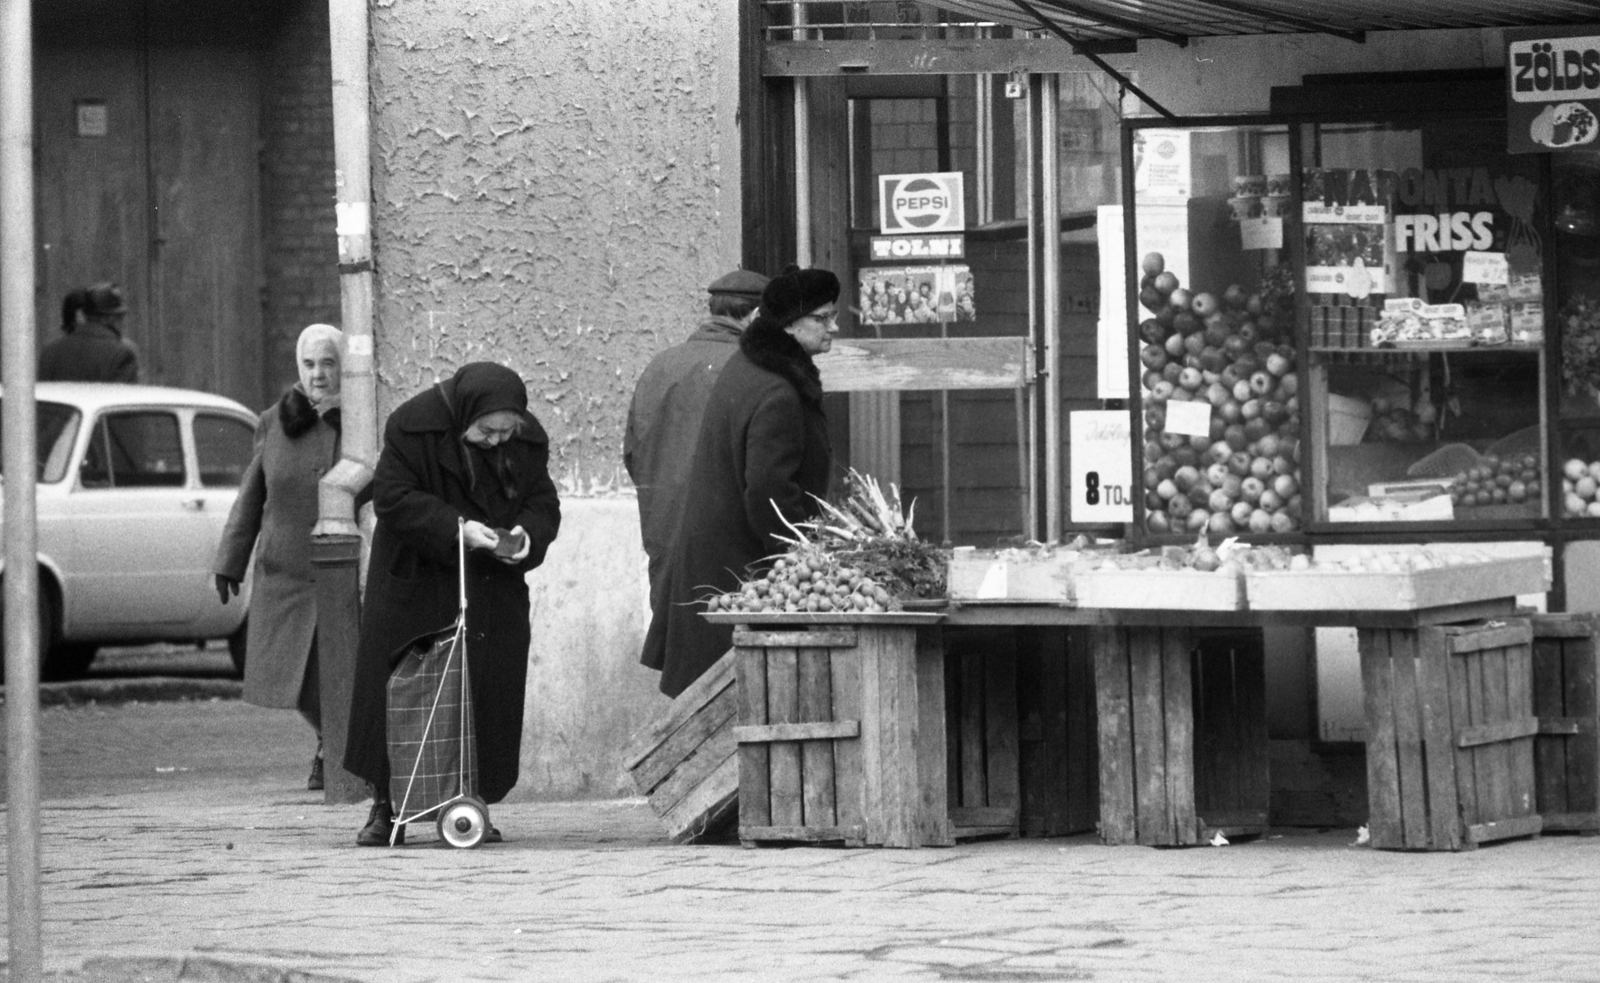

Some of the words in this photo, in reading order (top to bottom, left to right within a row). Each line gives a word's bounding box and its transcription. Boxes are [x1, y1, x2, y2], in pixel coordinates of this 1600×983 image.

[1515, 42, 1600, 92] ZÖLDS
[896, 196, 948, 210] PEPSI
[1322, 167, 1497, 207] NAPONTA
[873, 239, 962, 257] TOLNI
[1395, 211, 1494, 252] FRISS
[1086, 471, 1100, 506] 8
[1103, 485, 1132, 506] TOJ
